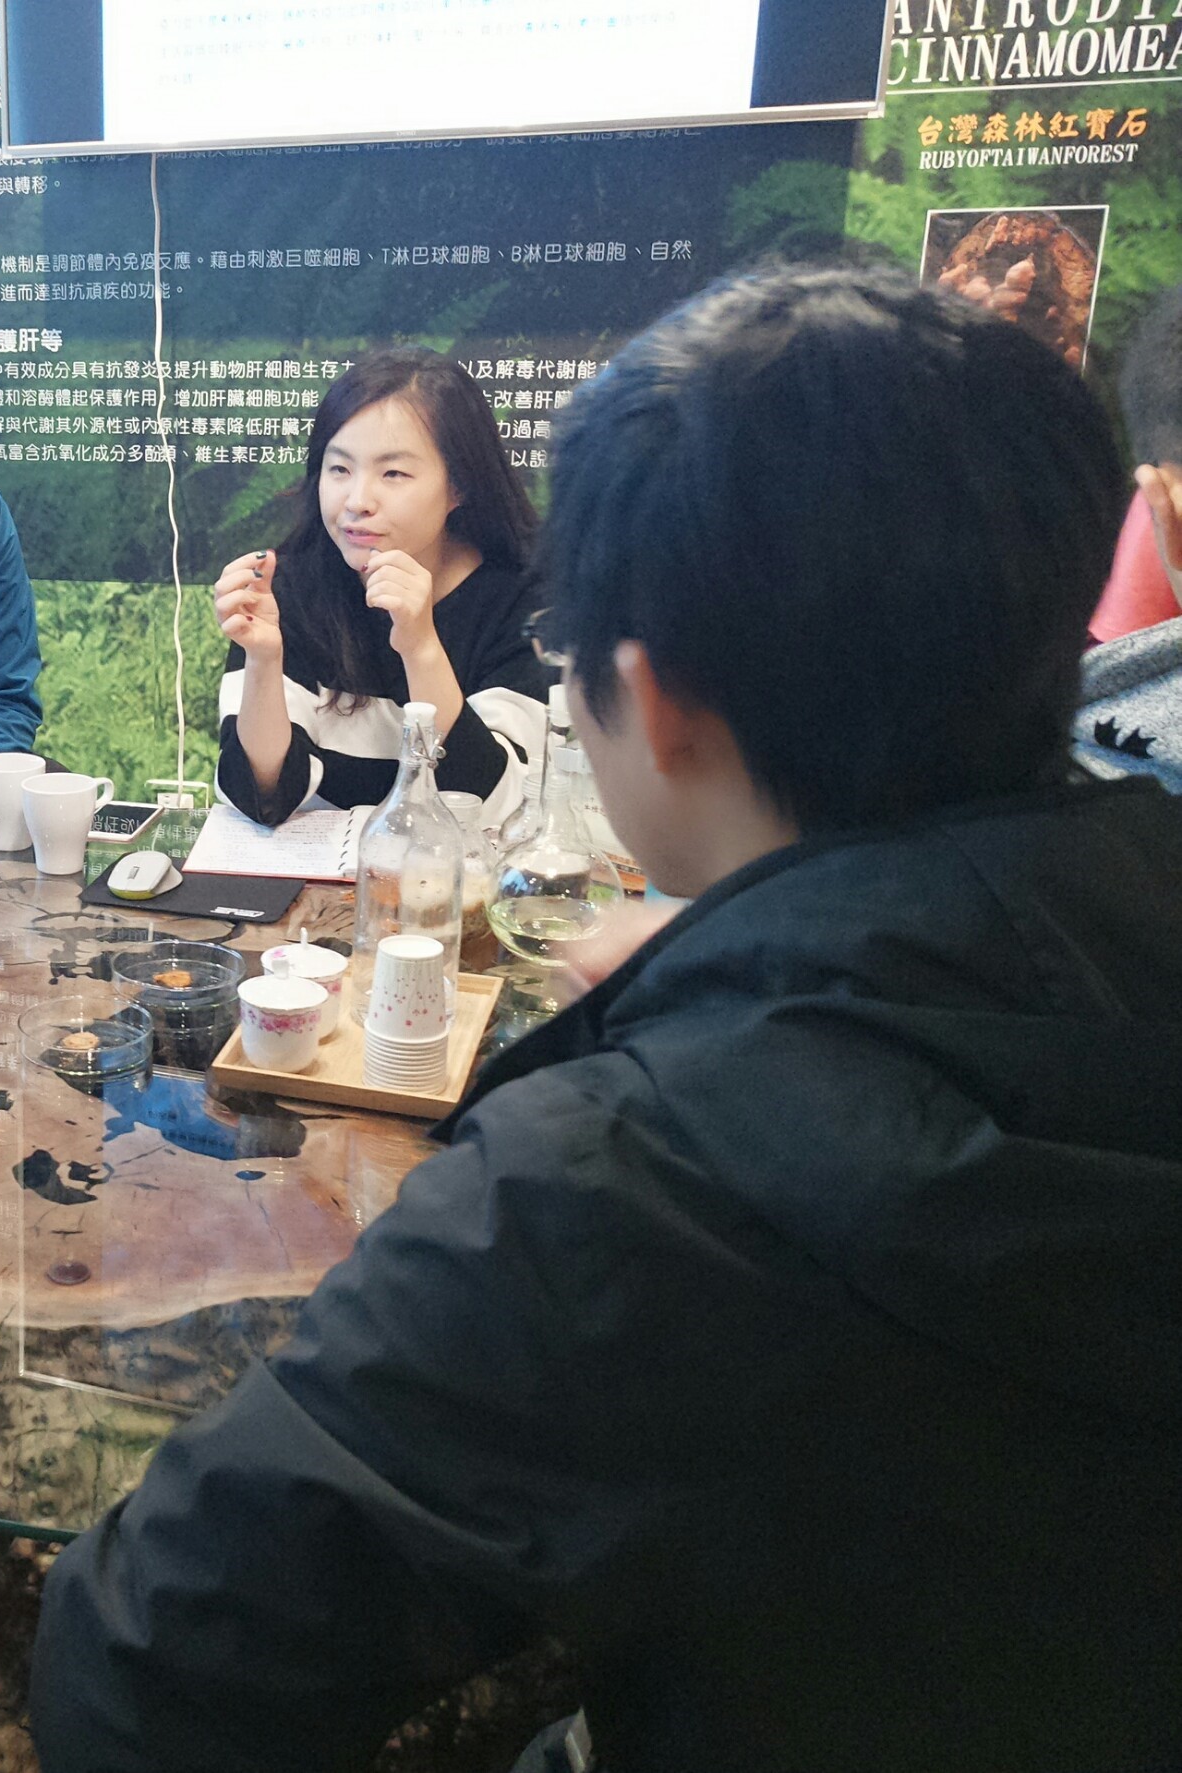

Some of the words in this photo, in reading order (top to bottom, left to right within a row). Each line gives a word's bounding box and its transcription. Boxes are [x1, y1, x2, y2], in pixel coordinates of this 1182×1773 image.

[918, 107, 1148, 147] 台灣森林紅寶石
